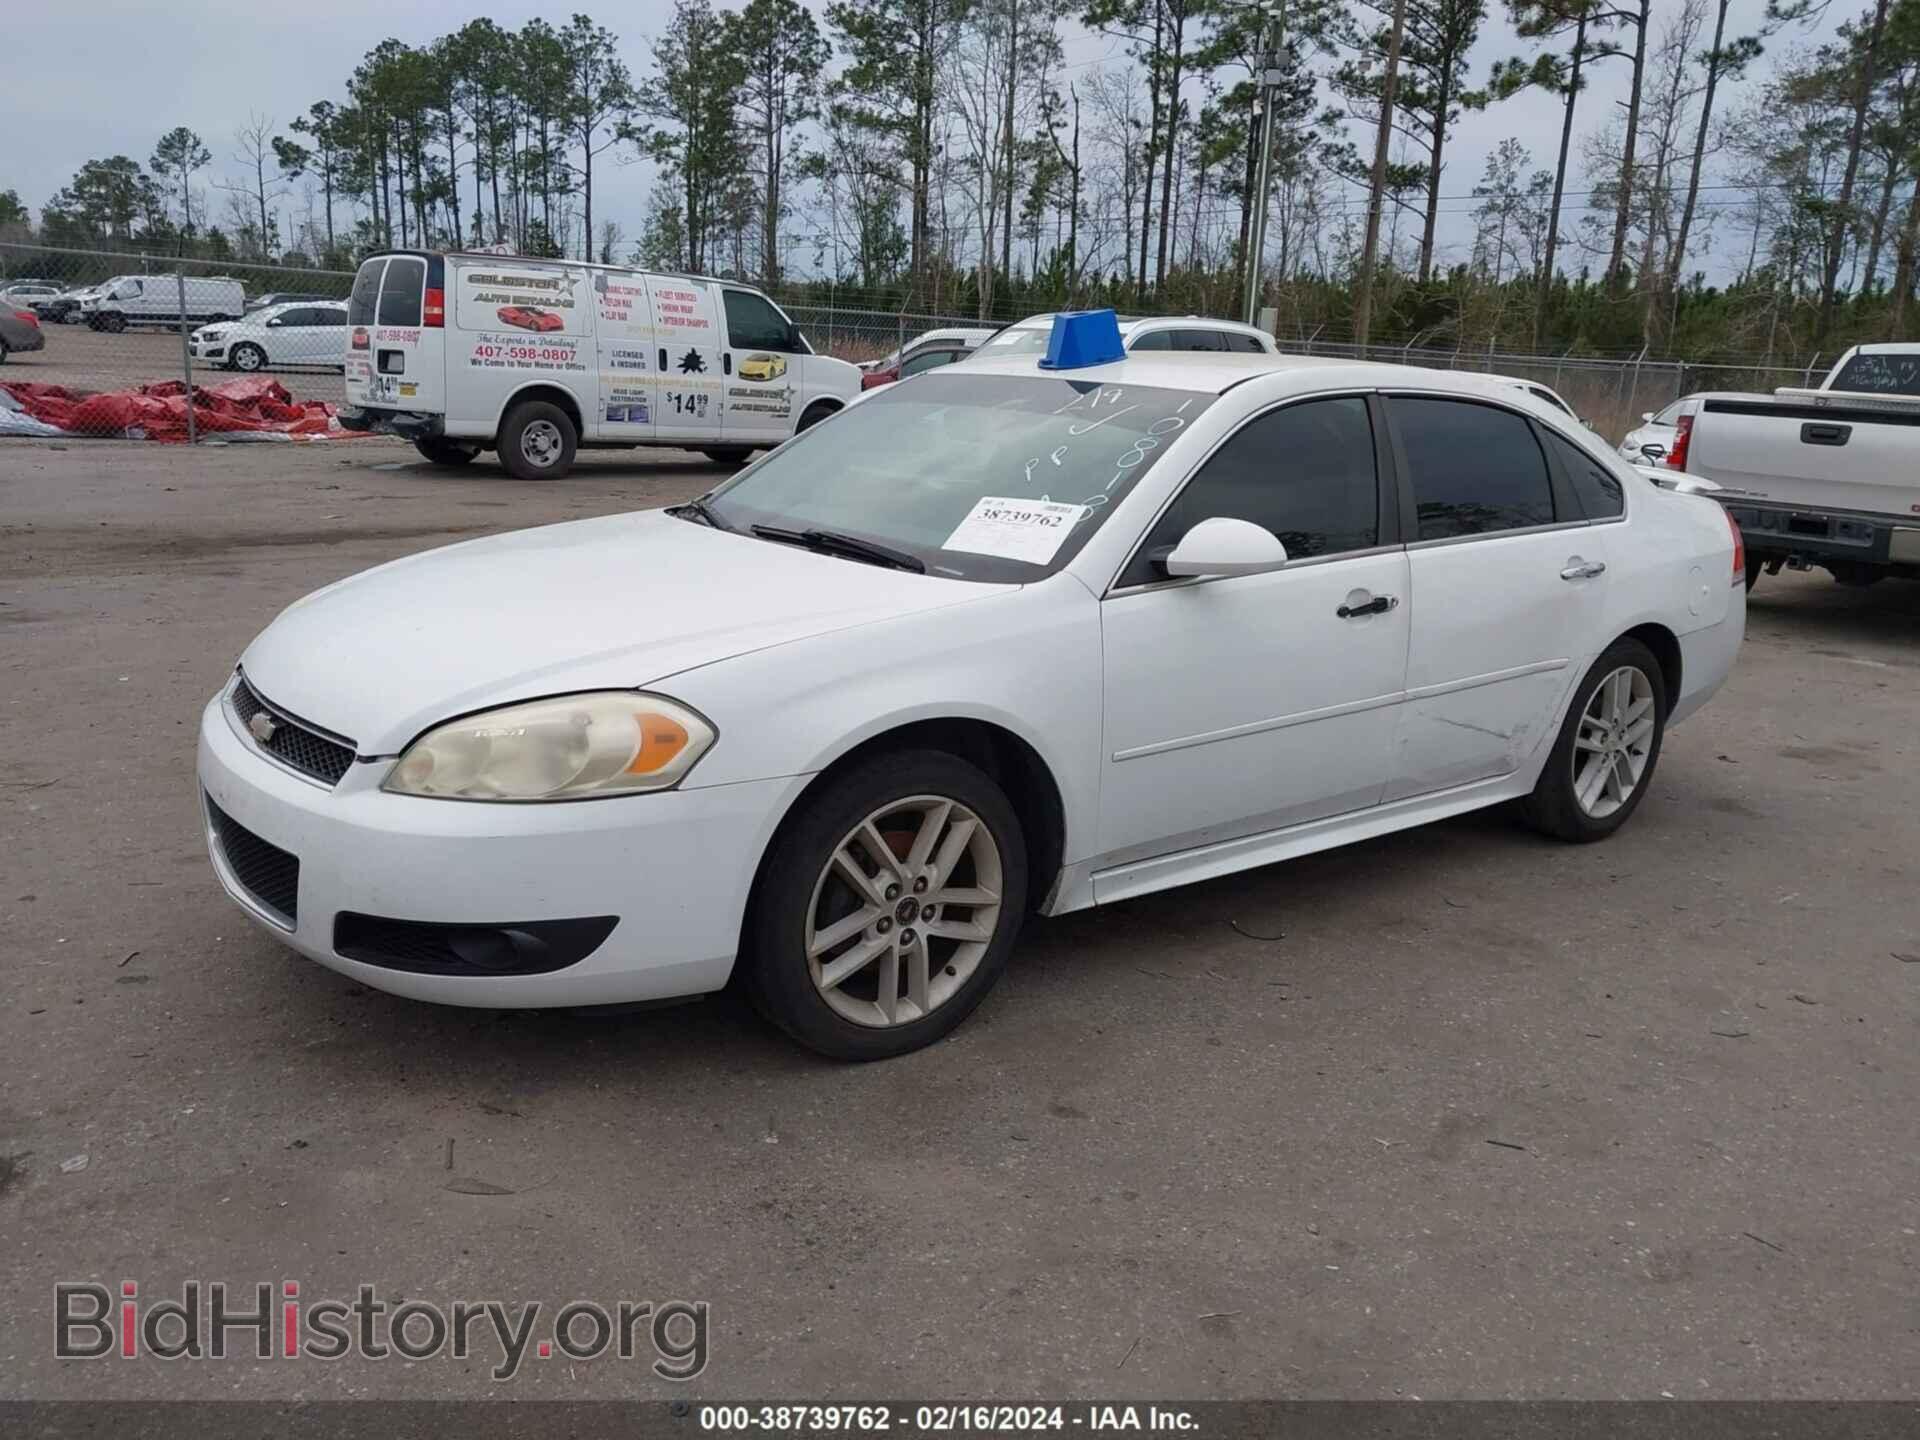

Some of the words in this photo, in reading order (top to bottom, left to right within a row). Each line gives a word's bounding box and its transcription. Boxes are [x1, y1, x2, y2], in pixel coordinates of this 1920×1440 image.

[473, 293, 511, 303] AUTO
[478, 333, 493, 343] The
[494, 335, 526, 347] Experts
[475, 346, 577, 361] 407-598-0807
[612, 350, 644, 359] LICENSED
[470, 358, 483, 367] We
[484, 359, 506, 368] Come
[507, 360, 516, 368] to
[517, 360, 533, 369] Your
[534, 361, 554, 370] Home
[565, 362, 586, 371] Office
[617, 361, 646, 369] INSURED
[977, 508, 1063, 528] 38739762
